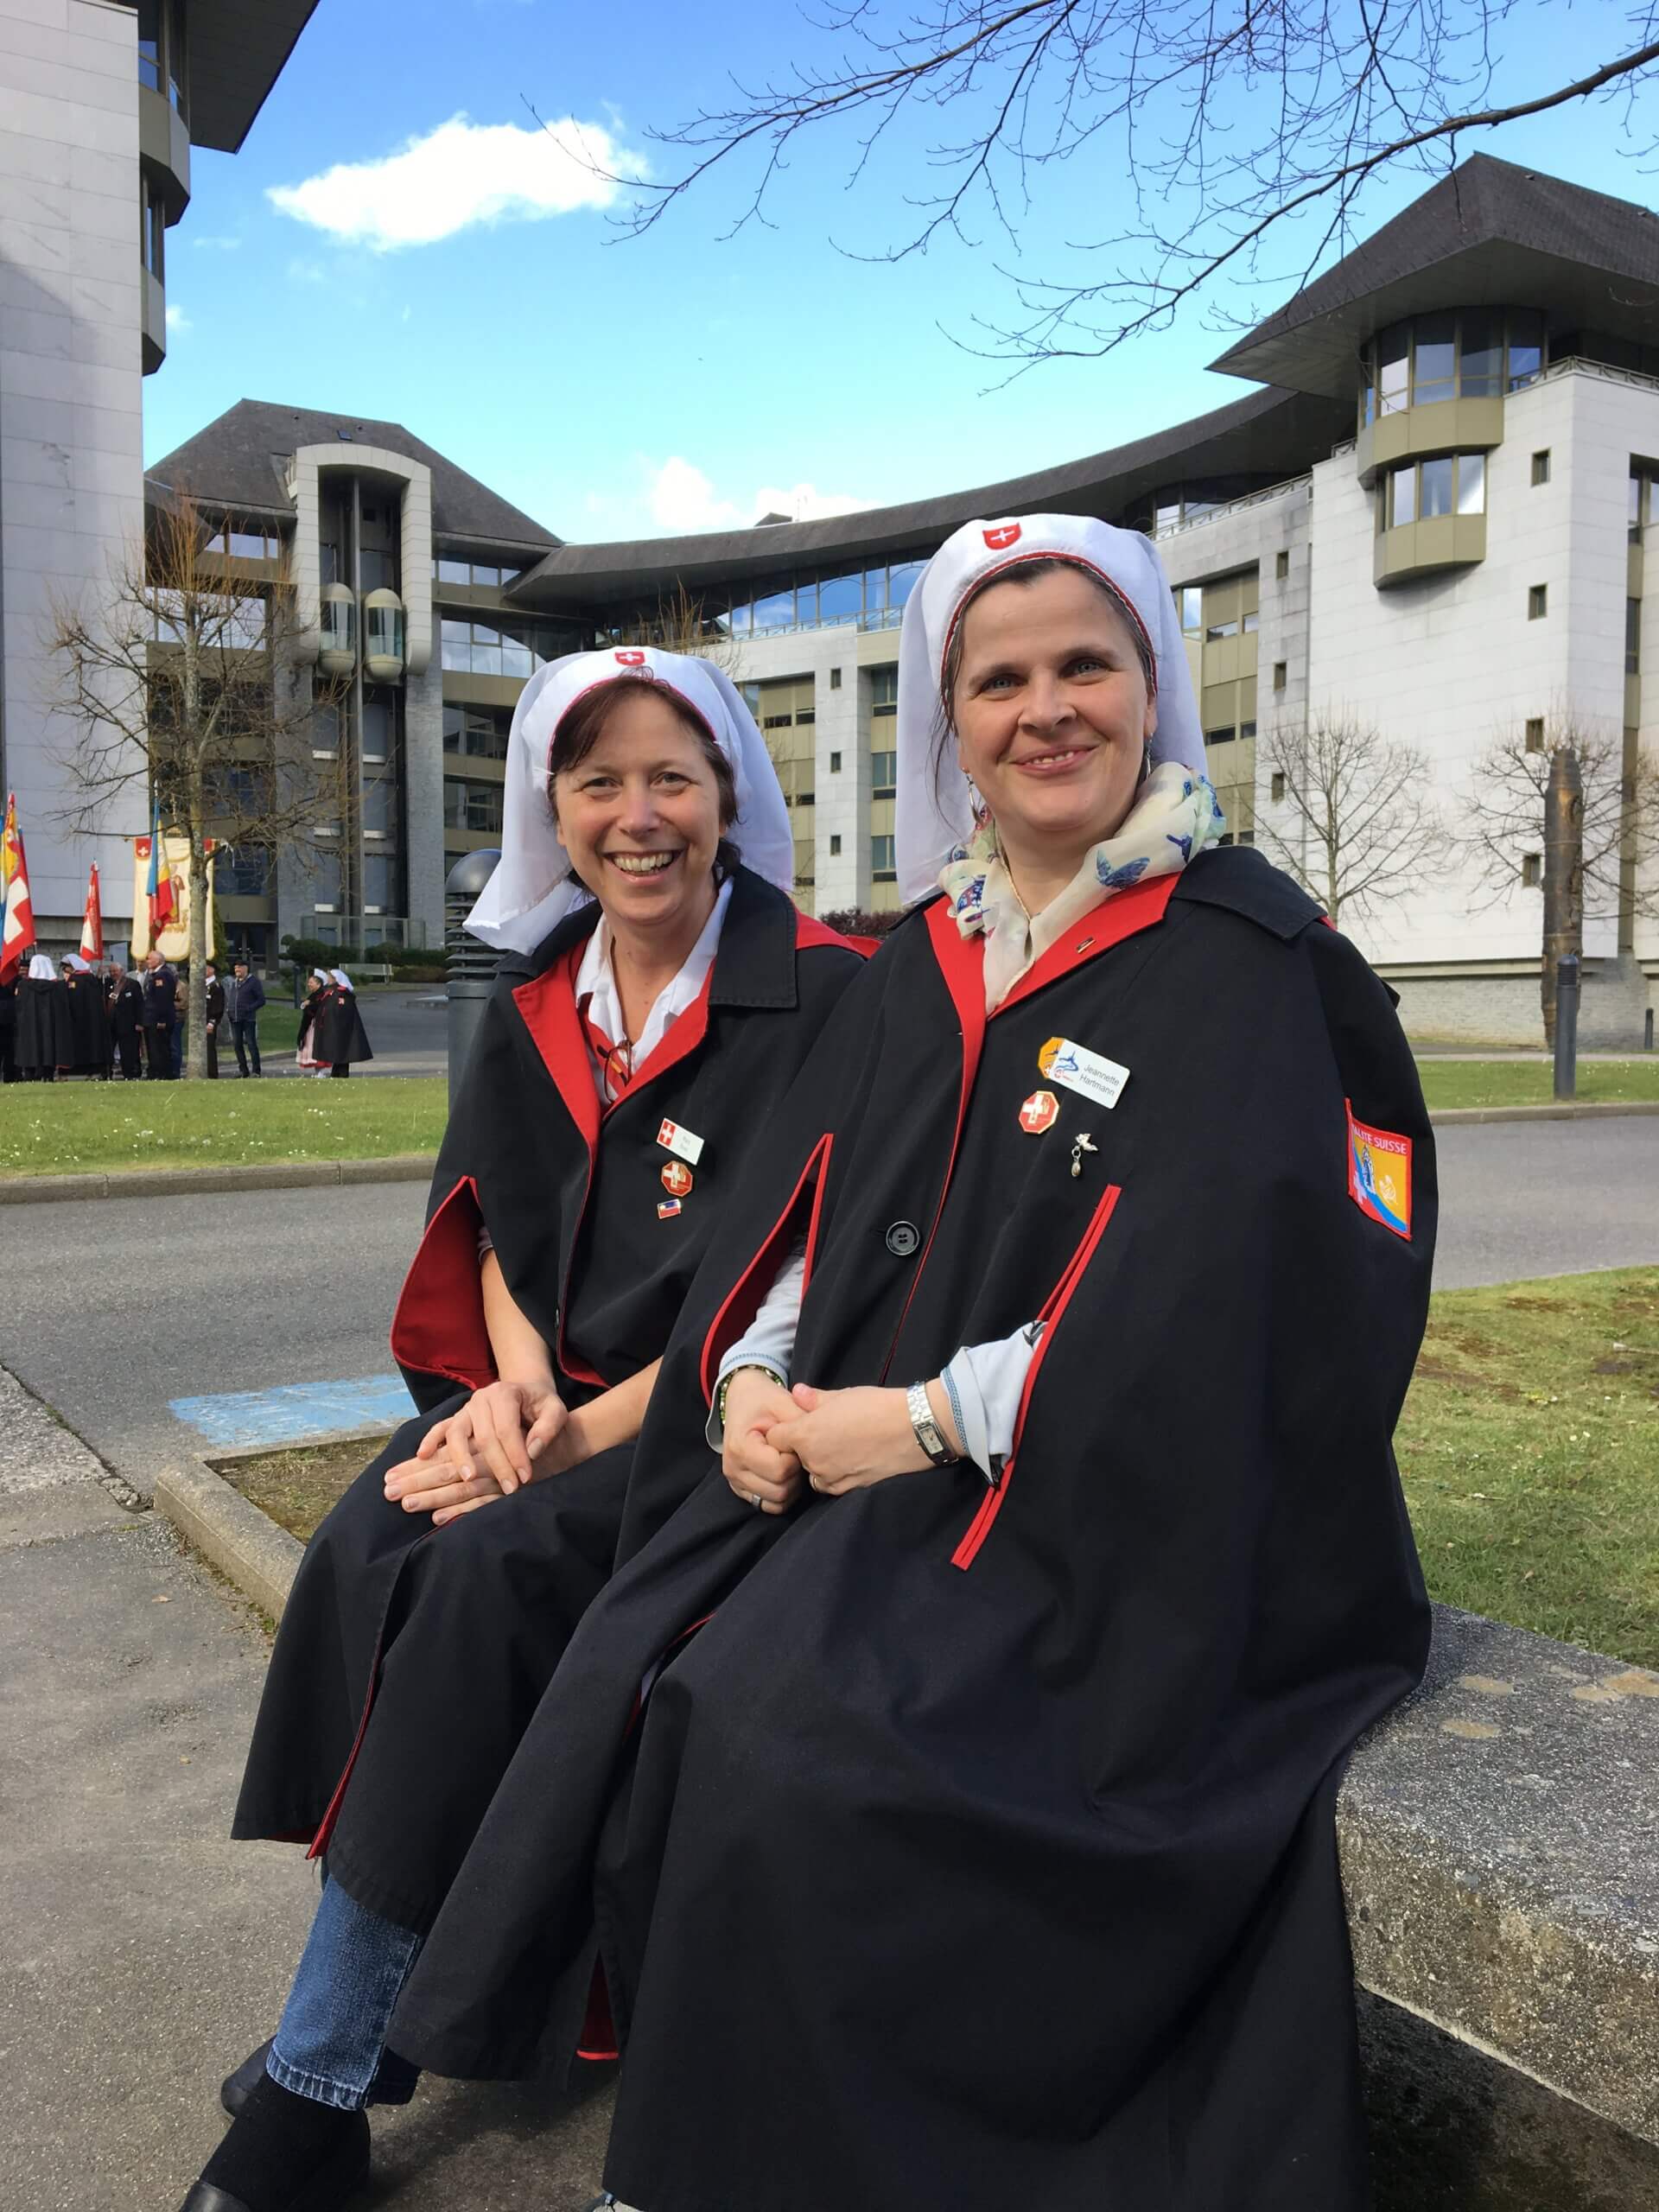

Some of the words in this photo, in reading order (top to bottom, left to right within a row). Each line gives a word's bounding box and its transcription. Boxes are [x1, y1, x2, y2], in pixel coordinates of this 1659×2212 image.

[1079, 1074, 1115, 1096] Hartmann
[1084, 1065, 1120, 1085] Jeannette
[1374, 1137, 1407, 1154] SUISSE
